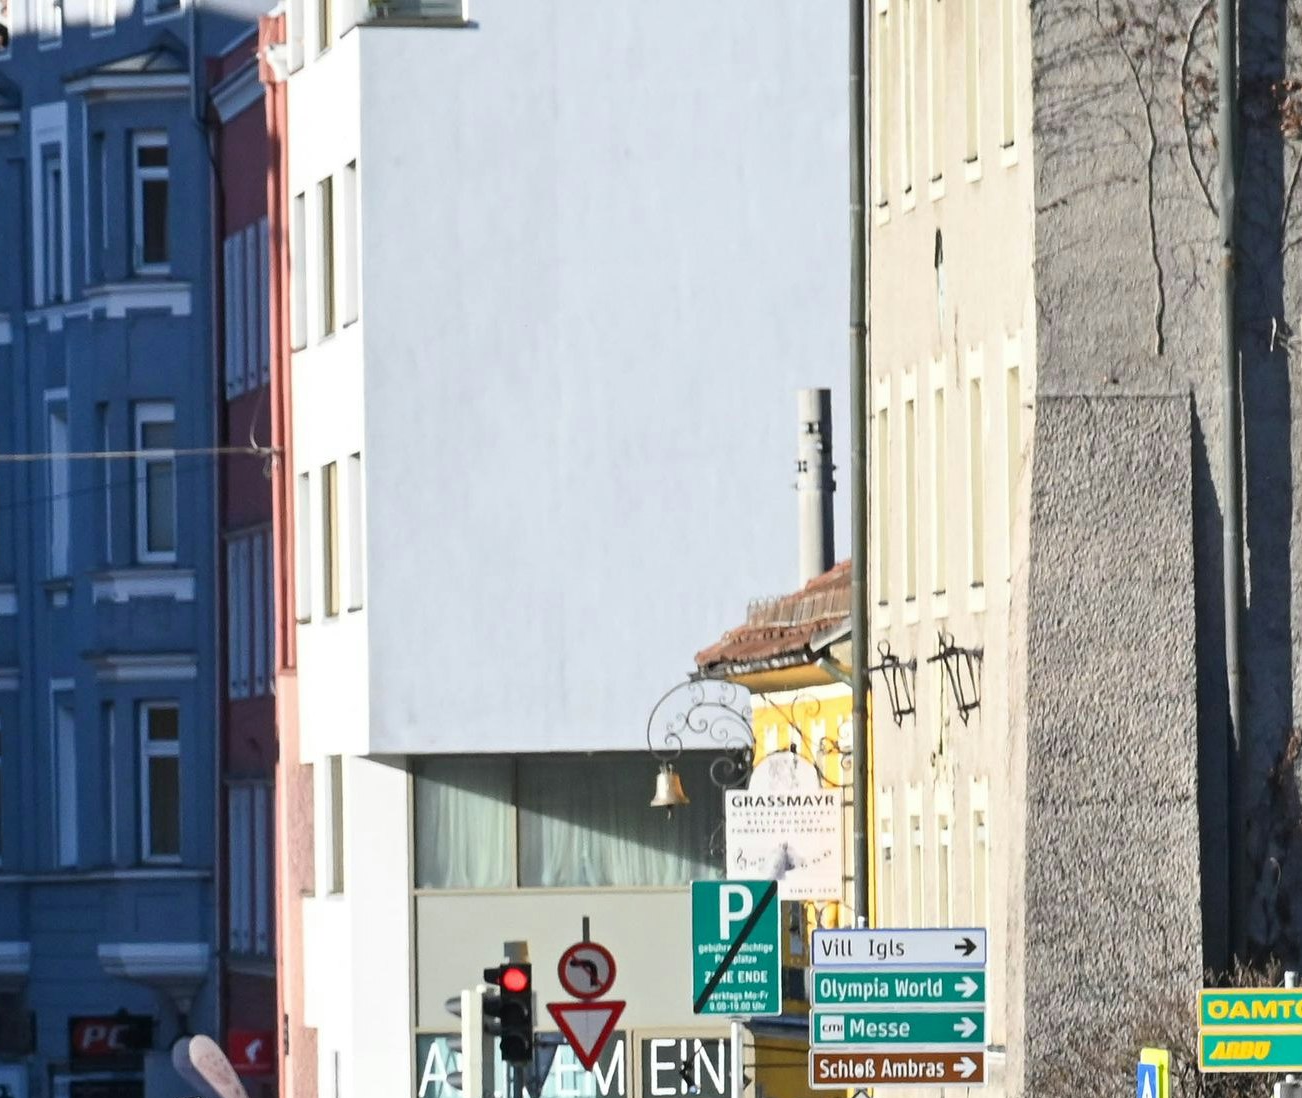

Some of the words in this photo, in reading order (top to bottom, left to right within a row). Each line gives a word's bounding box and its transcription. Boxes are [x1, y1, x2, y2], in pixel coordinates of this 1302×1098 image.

[731, 795, 835, 807] GRASSMAYR
[719, 884, 754, 940] P
[821, 938, 853, 957] Vill
[869, 938, 905, 960] Igls
[738, 970, 769, 983] ENDE
[820, 977, 889, 1001] Olympia
[895, 977, 943, 998] World
[850, 1018, 910, 1038] Messe
[819, 1058, 876, 1079] Schloß
[881, 1058, 945, 1078] Ambras
